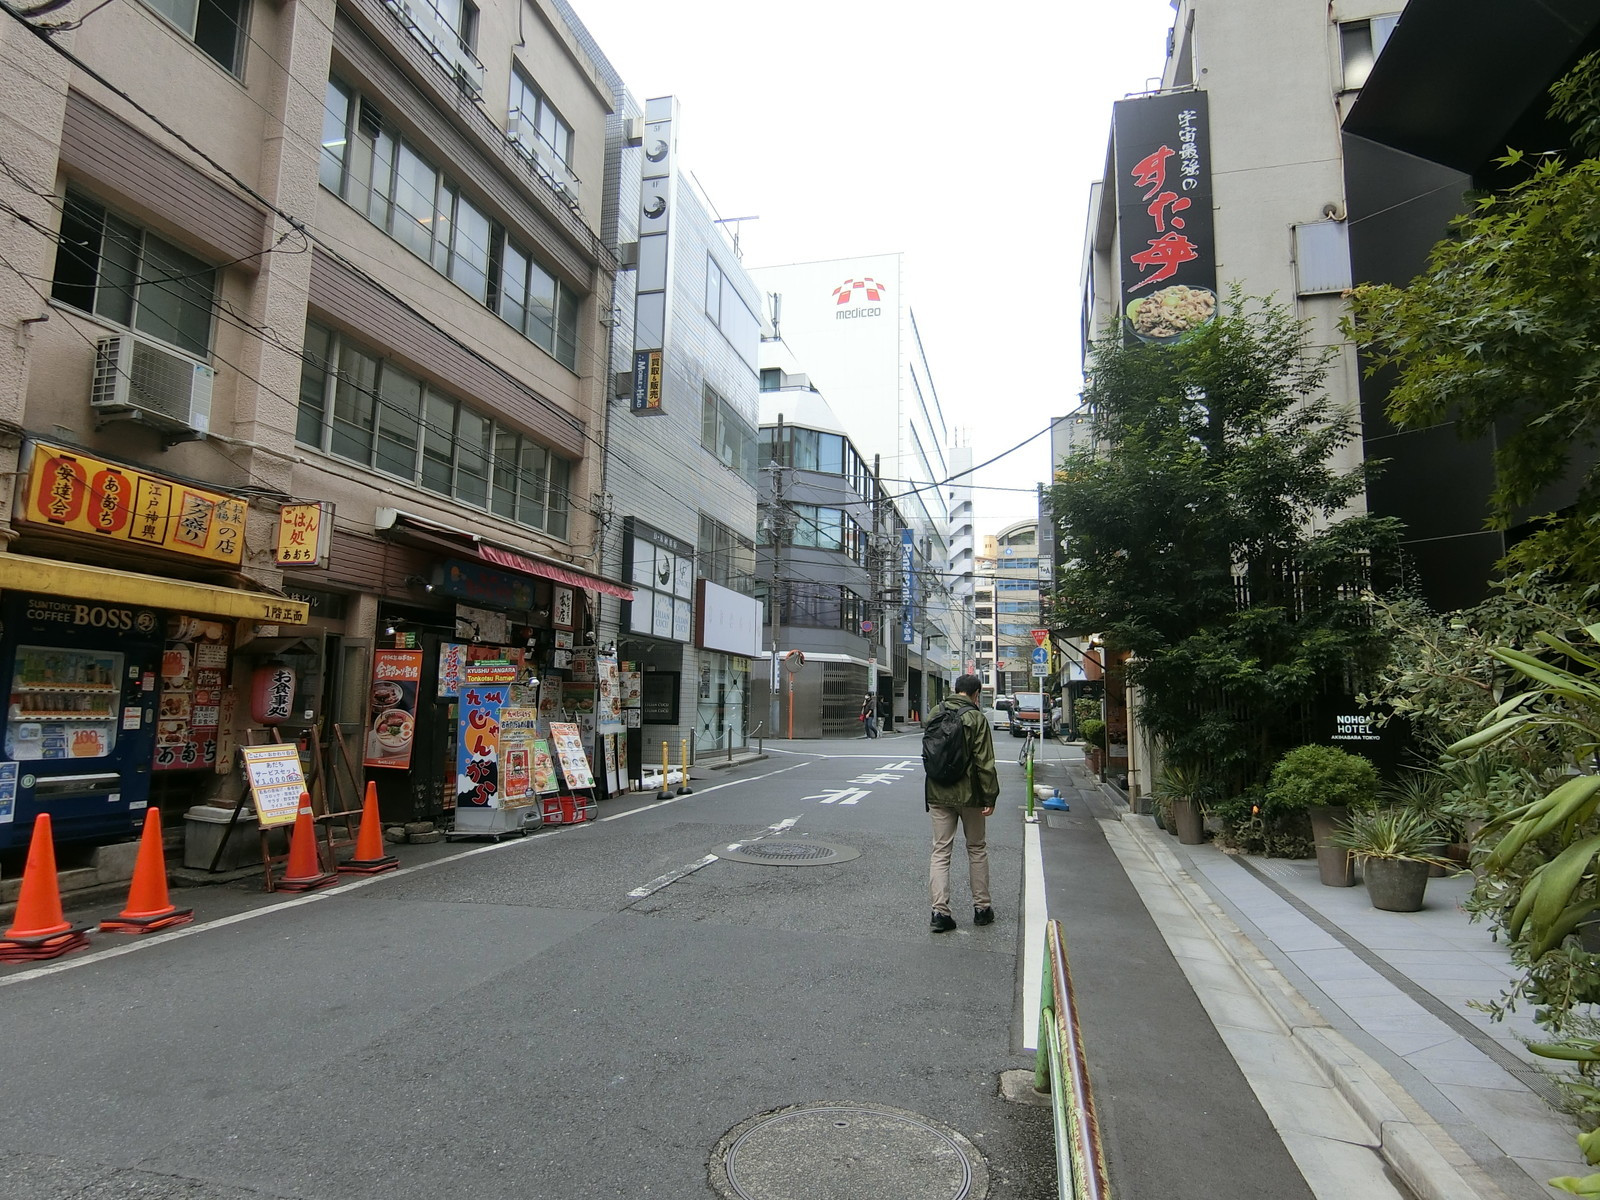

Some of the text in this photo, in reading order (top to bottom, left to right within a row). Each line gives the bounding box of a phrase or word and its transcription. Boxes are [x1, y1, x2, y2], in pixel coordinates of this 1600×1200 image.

[1178, 110, 1200, 191] 宇宙最強の
[1127, 144, 1198, 293] すた丼
[836, 306, 881, 320] mediceo
[51, 464, 76, 518] 安達会
[283, 507, 317, 532] ごはん
[215, 527, 237, 554] の店
[290, 529, 305, 545] 処
[902, 544, 912, 606] Panasonic
[26, 604, 133, 630] COFFEE BOSS
[29, 600, 72, 610] SUNTORY
[264, 605, 303, 621] 1階正面
[267, 669, 294, 718] お食事処
[466, 689, 503, 706] 九州
[1336, 715, 1371, 724] NOHGA
[1337, 725, 1373, 734] HOTEL
[466, 709, 500, 805] じゃんがら
[256, 768, 297, 777] サービスセット
